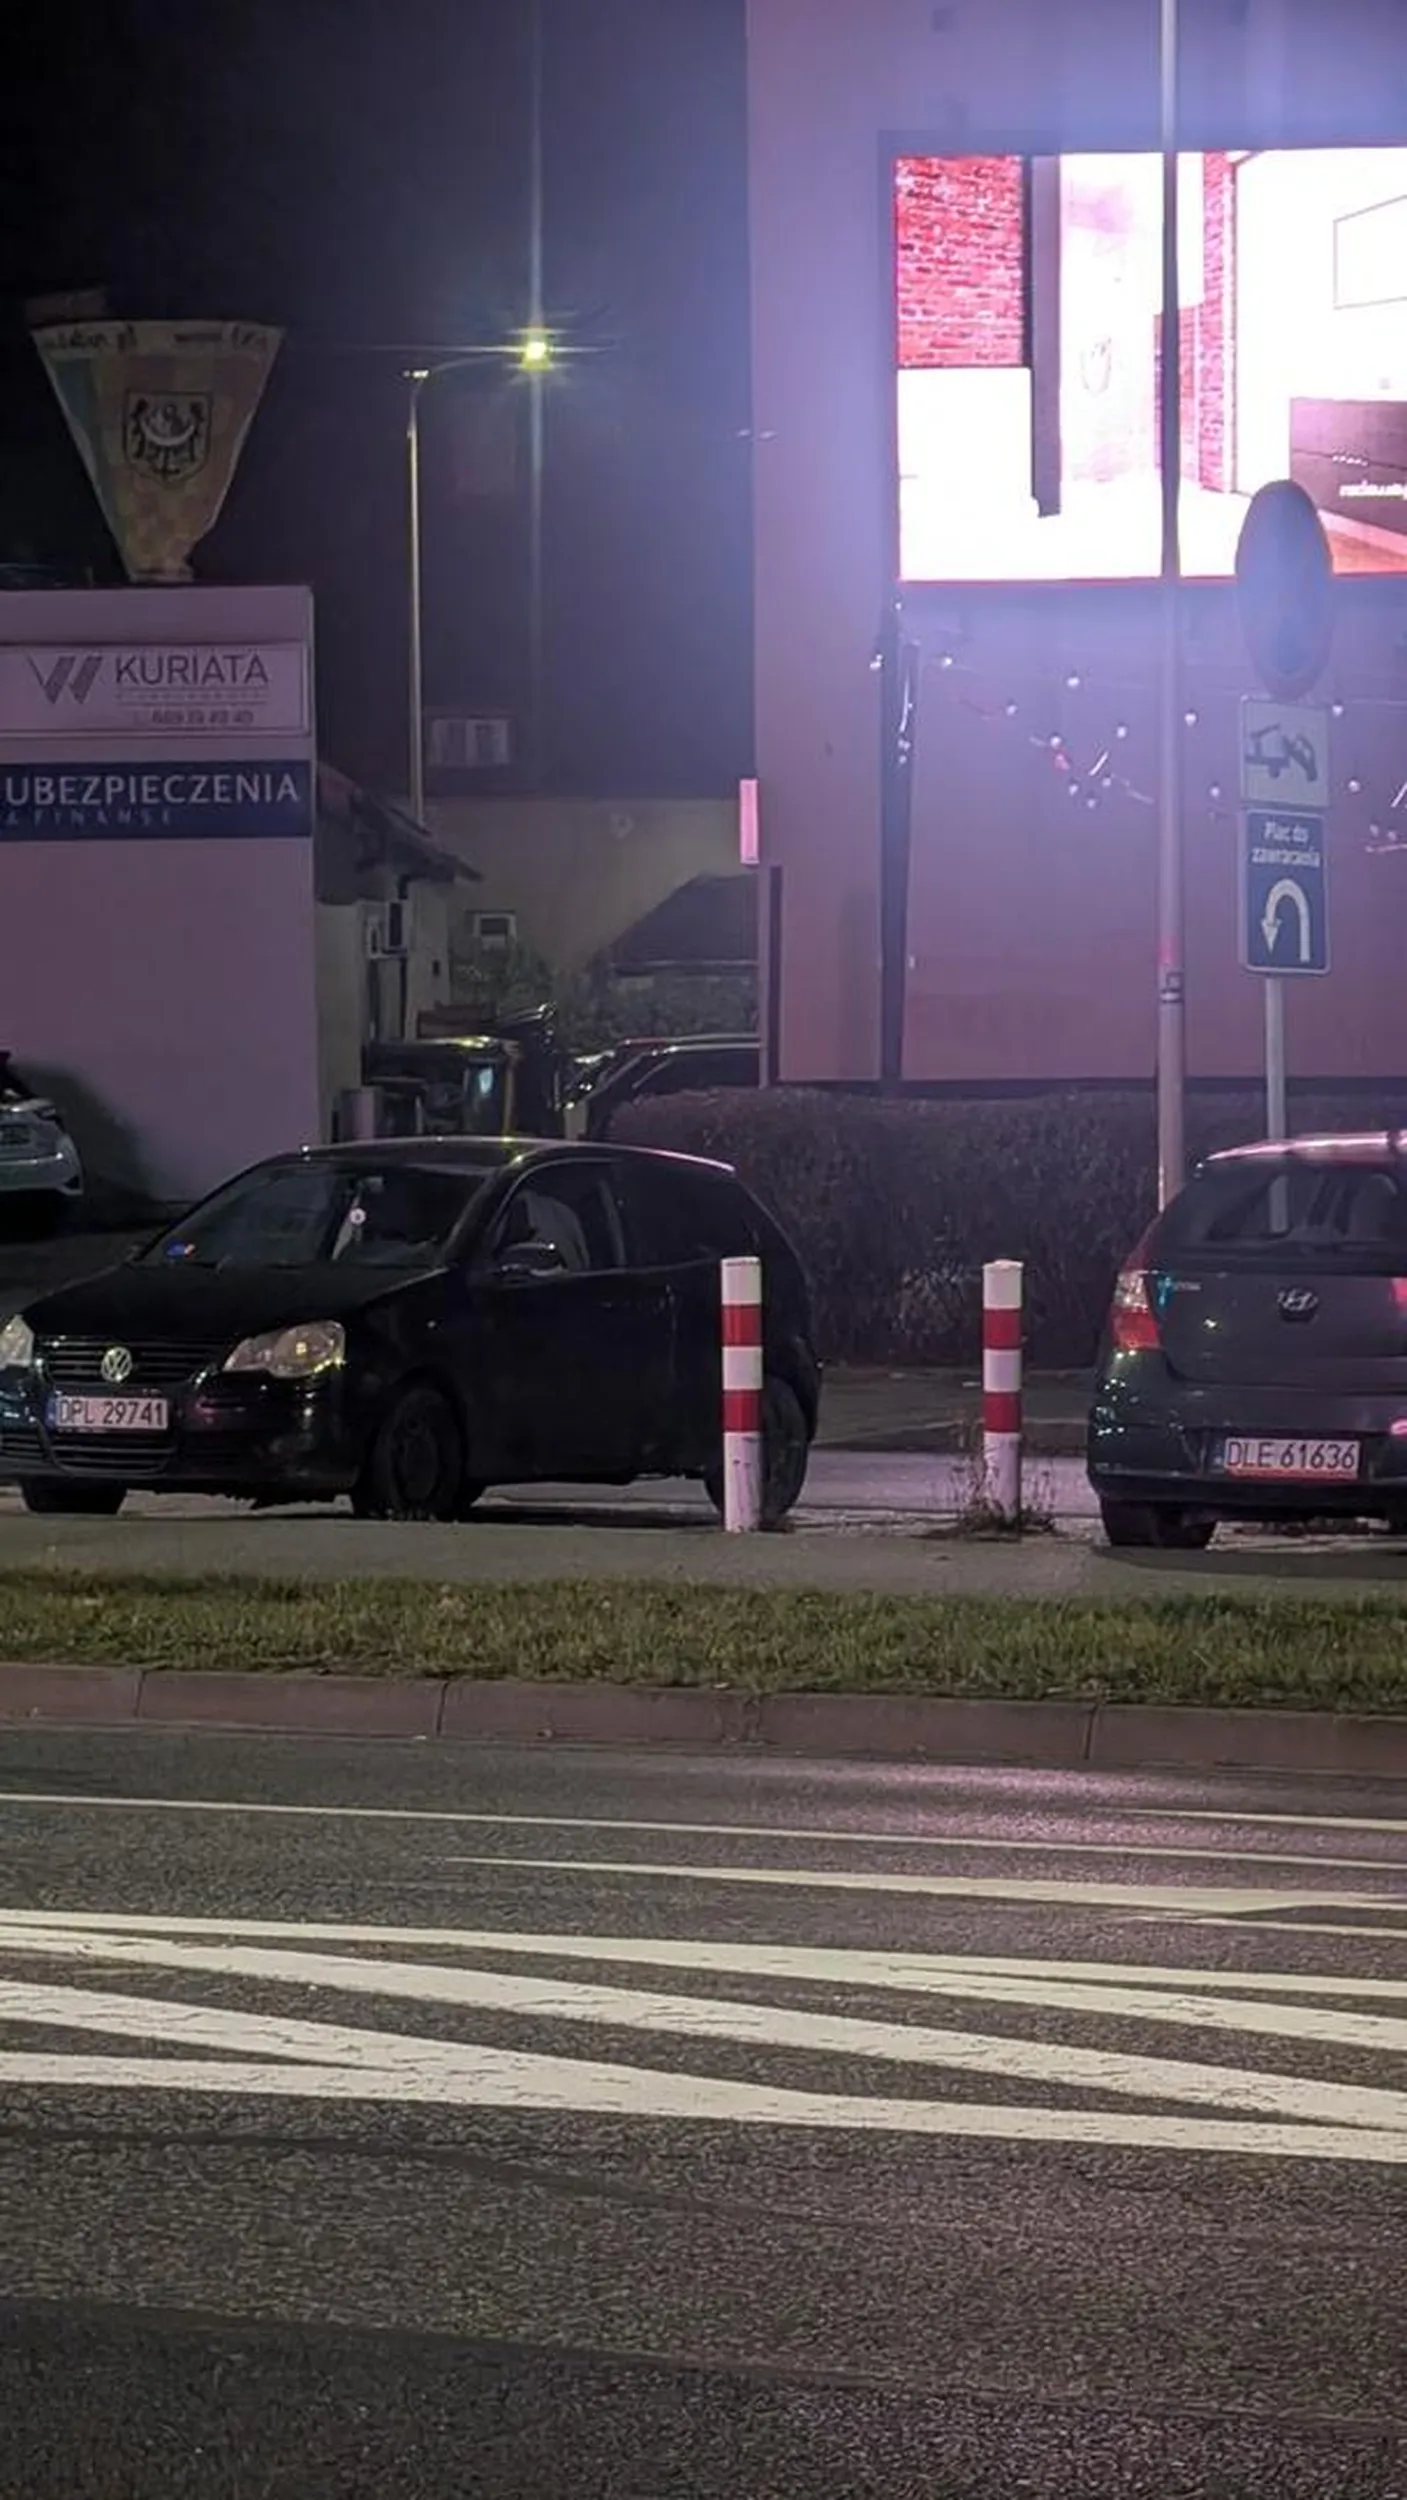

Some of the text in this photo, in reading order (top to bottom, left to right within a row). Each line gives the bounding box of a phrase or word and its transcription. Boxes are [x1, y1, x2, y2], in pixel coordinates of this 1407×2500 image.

[114, 654, 269, 684] KURIATA
[5, 773, 299, 806] UBEZPIECZENIA
[59, 1399, 164, 1427] DPL 29741
[1228, 1441, 1356, 1469] DLE 61636
